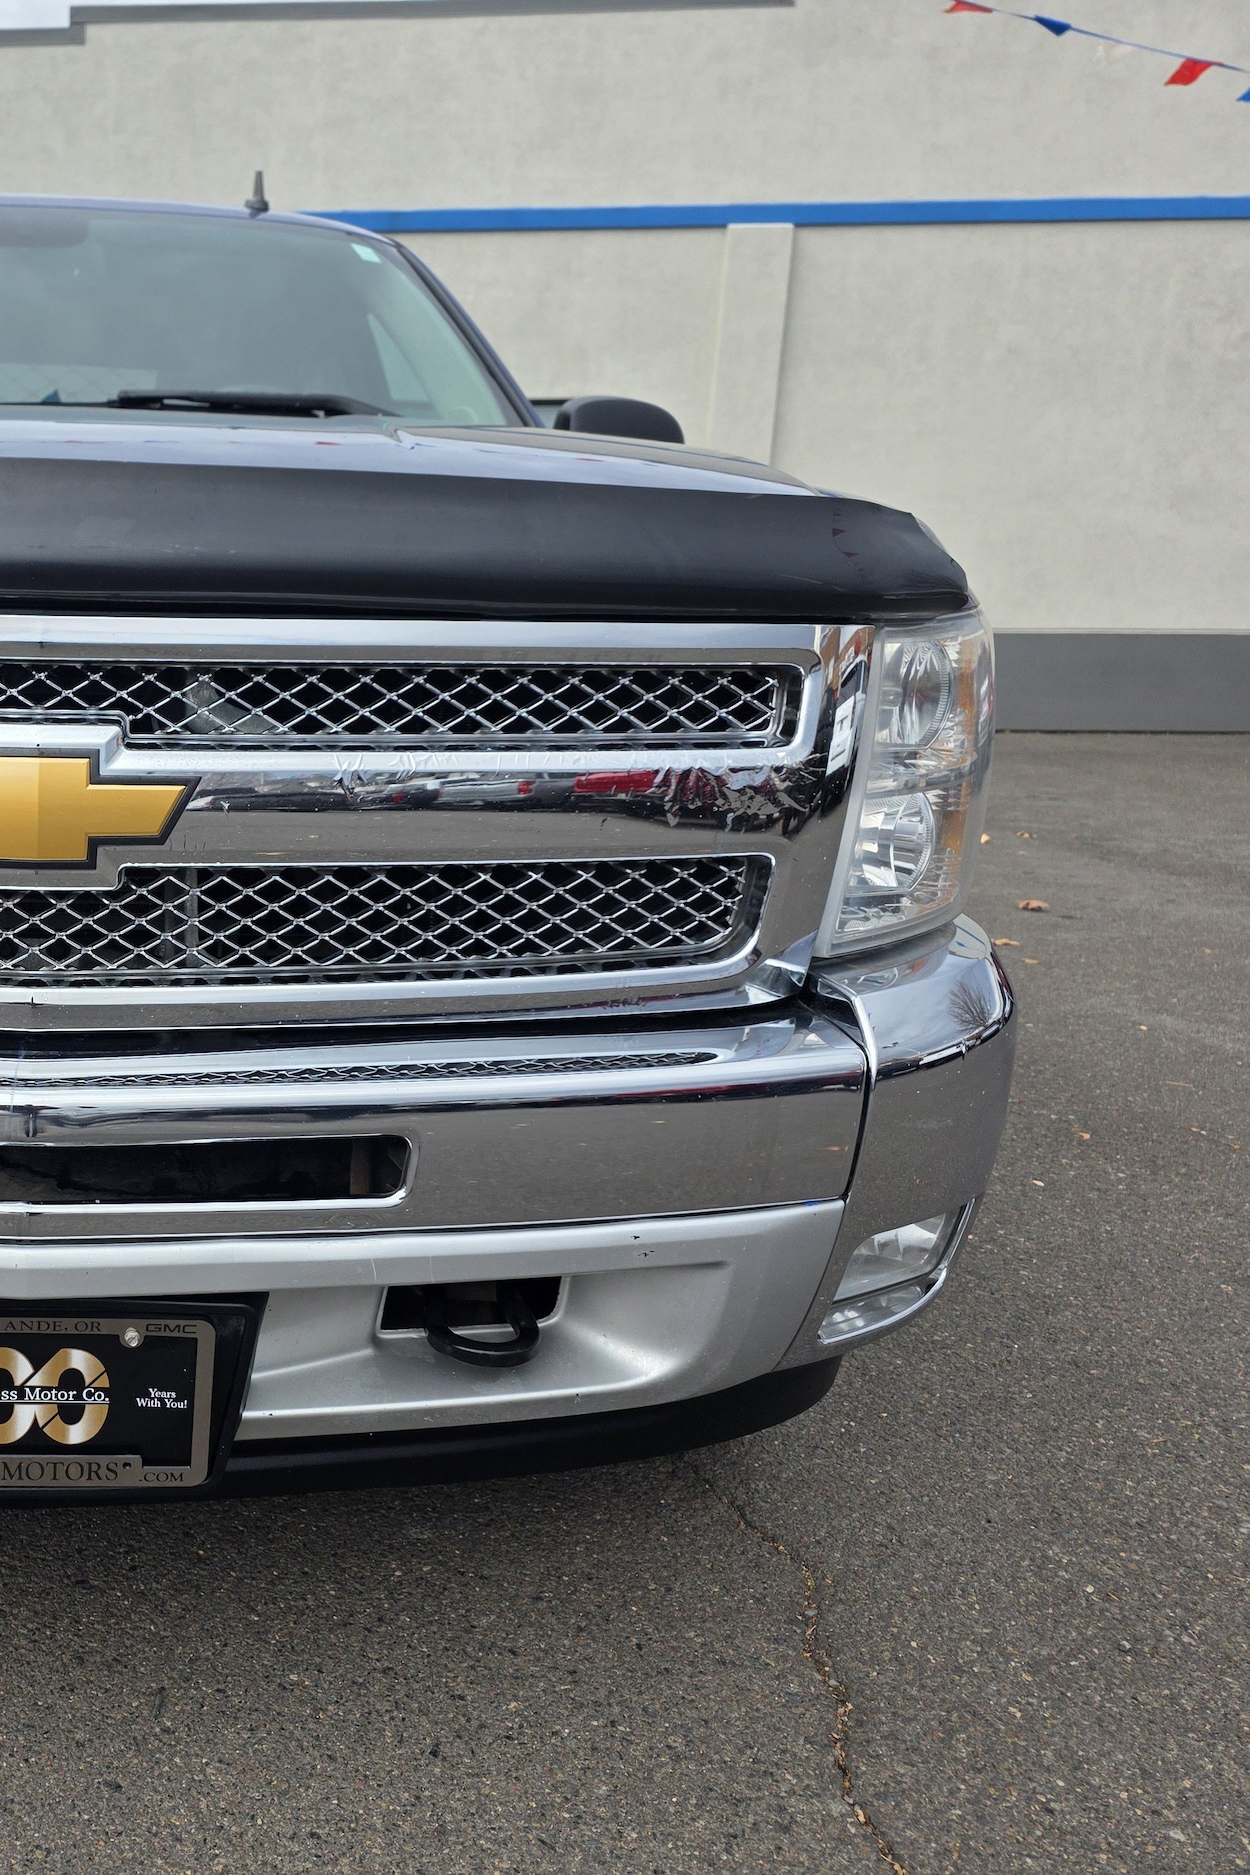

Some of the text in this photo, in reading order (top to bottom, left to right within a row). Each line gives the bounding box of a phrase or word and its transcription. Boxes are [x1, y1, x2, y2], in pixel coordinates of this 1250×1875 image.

[74, 1320, 102, 1332] OR
[146, 1323, 197, 1334] GMC
[23, 1387, 77, 1401] Motor
[82, 1387, 110, 1402] Co.
[148, 1388, 177, 1399] Years
[136, 1397, 188, 1409] With You!
[1, 1460, 118, 1481] MOTORS
[139, 1471, 184, 1483] .COM
